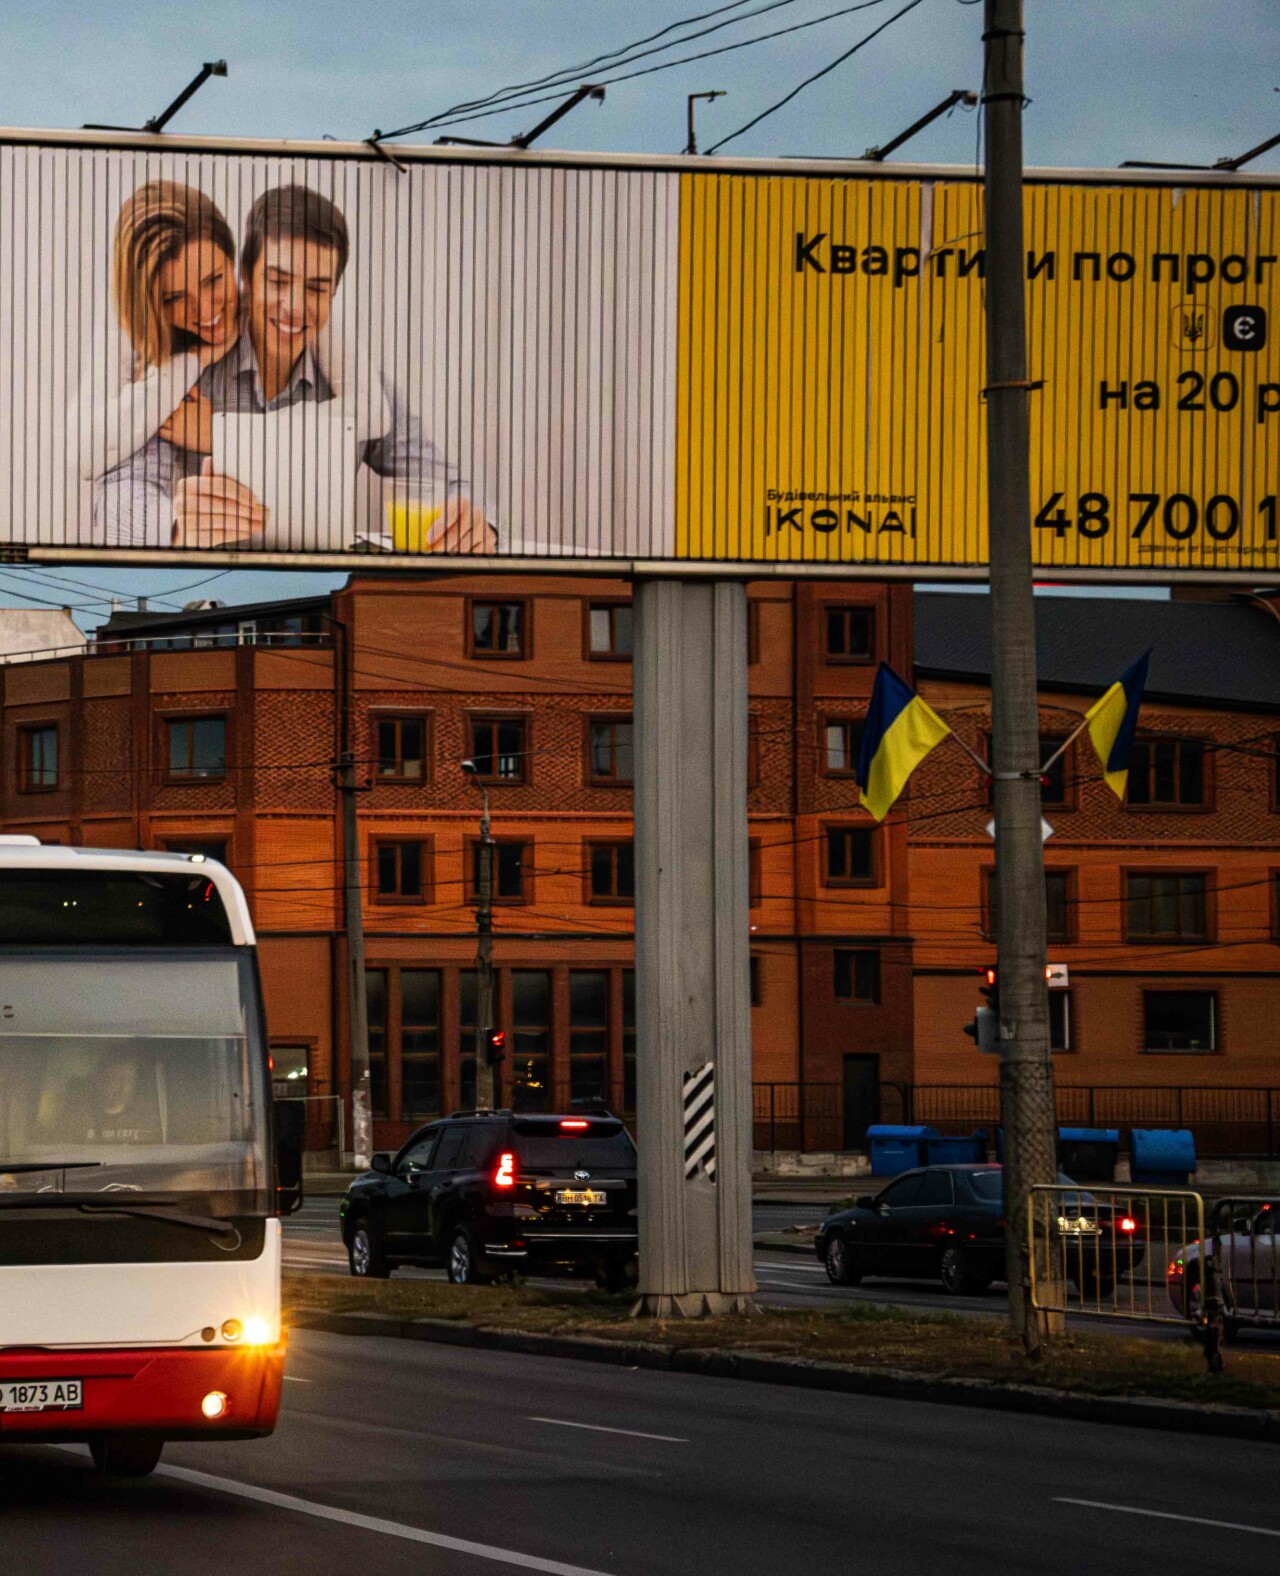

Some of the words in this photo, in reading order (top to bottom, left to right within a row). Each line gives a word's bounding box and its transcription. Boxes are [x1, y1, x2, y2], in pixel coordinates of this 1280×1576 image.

[796, 233, 1055, 286] Квартии
[1073, 252, 1135, 282] по
[1150, 253, 1278, 294] прог
[1100, 380, 1159, 411] на
[1177, 370, 1239, 412] 20
[1034, 492, 1109, 539] 48
[1128, 493, 1239, 541] 700
[9, 1385, 48, 1404] 1873
[54, 1383, 78, 1402] AB
